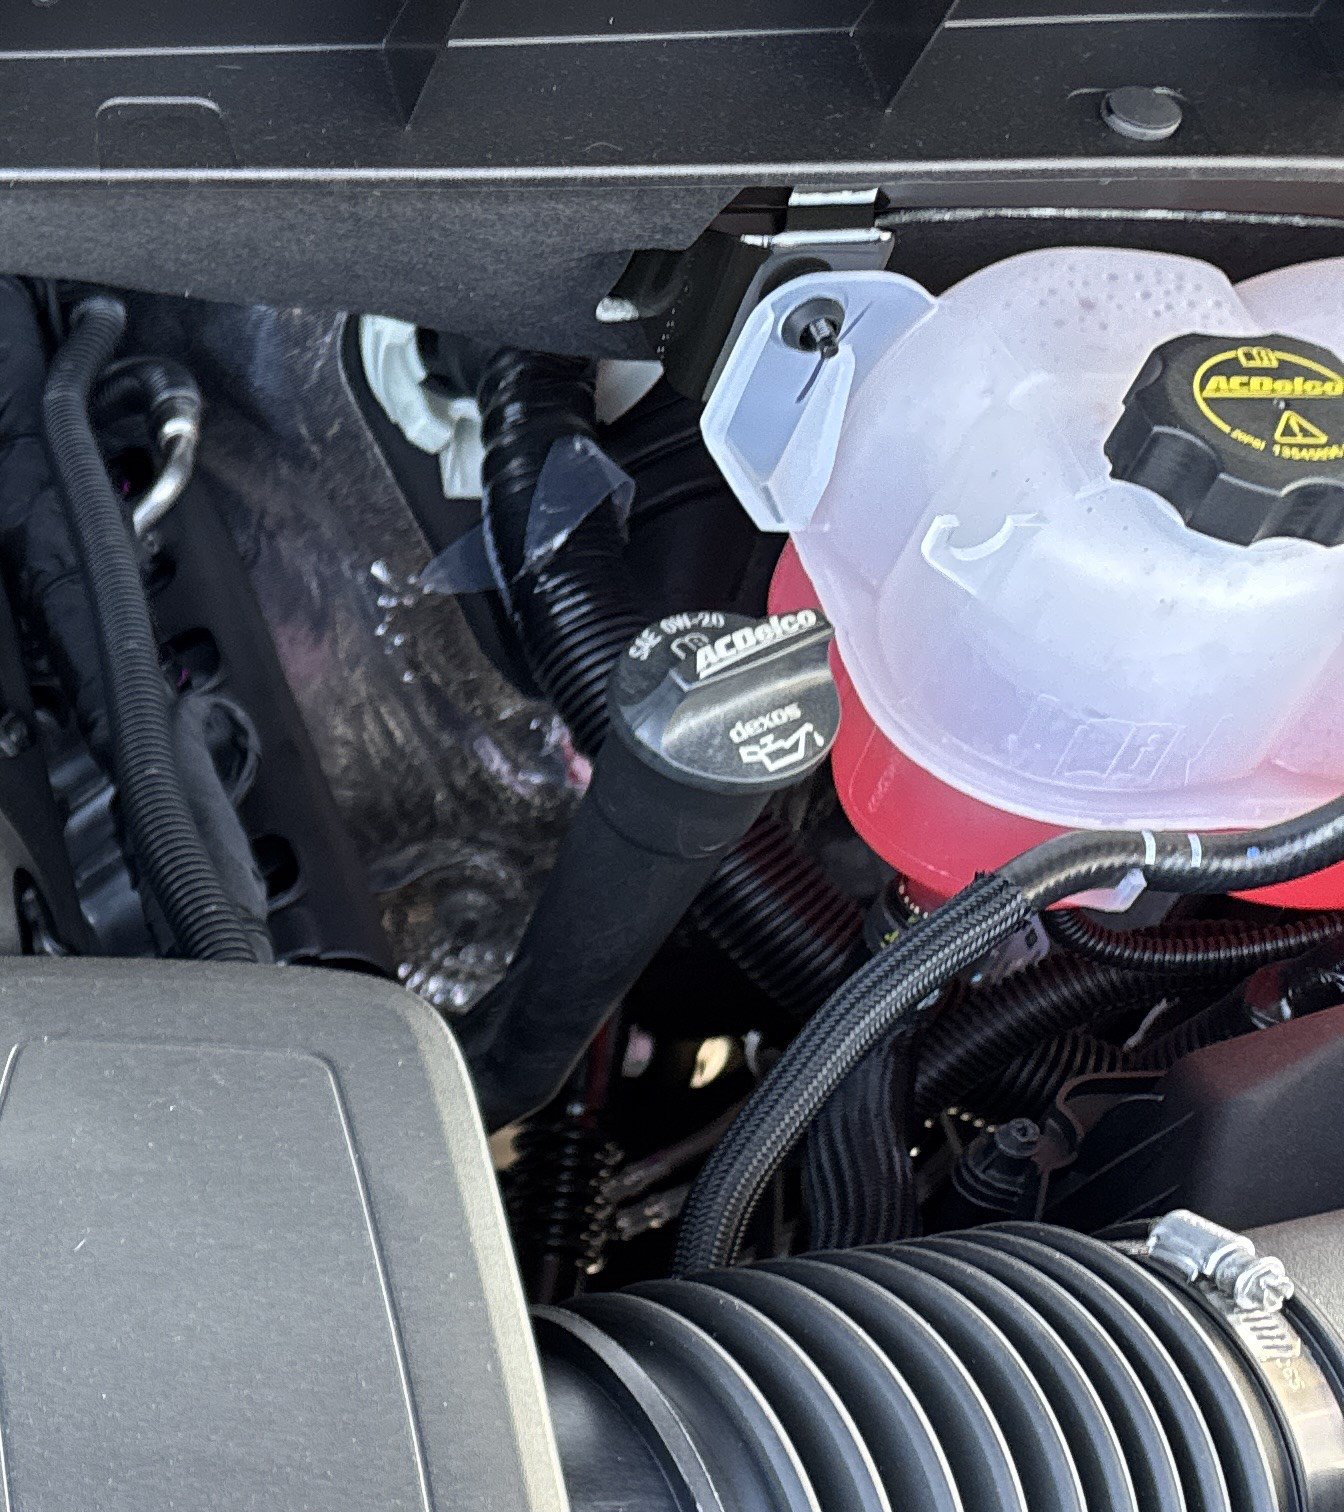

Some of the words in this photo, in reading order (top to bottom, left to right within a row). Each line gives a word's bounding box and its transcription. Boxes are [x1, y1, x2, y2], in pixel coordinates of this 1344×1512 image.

[1203, 375, 1344, 397] ACDelco
[628, 628, 662, 662] SAE
[696, 609, 818, 675] ACDelco
[729, 702, 803, 744] dexos
